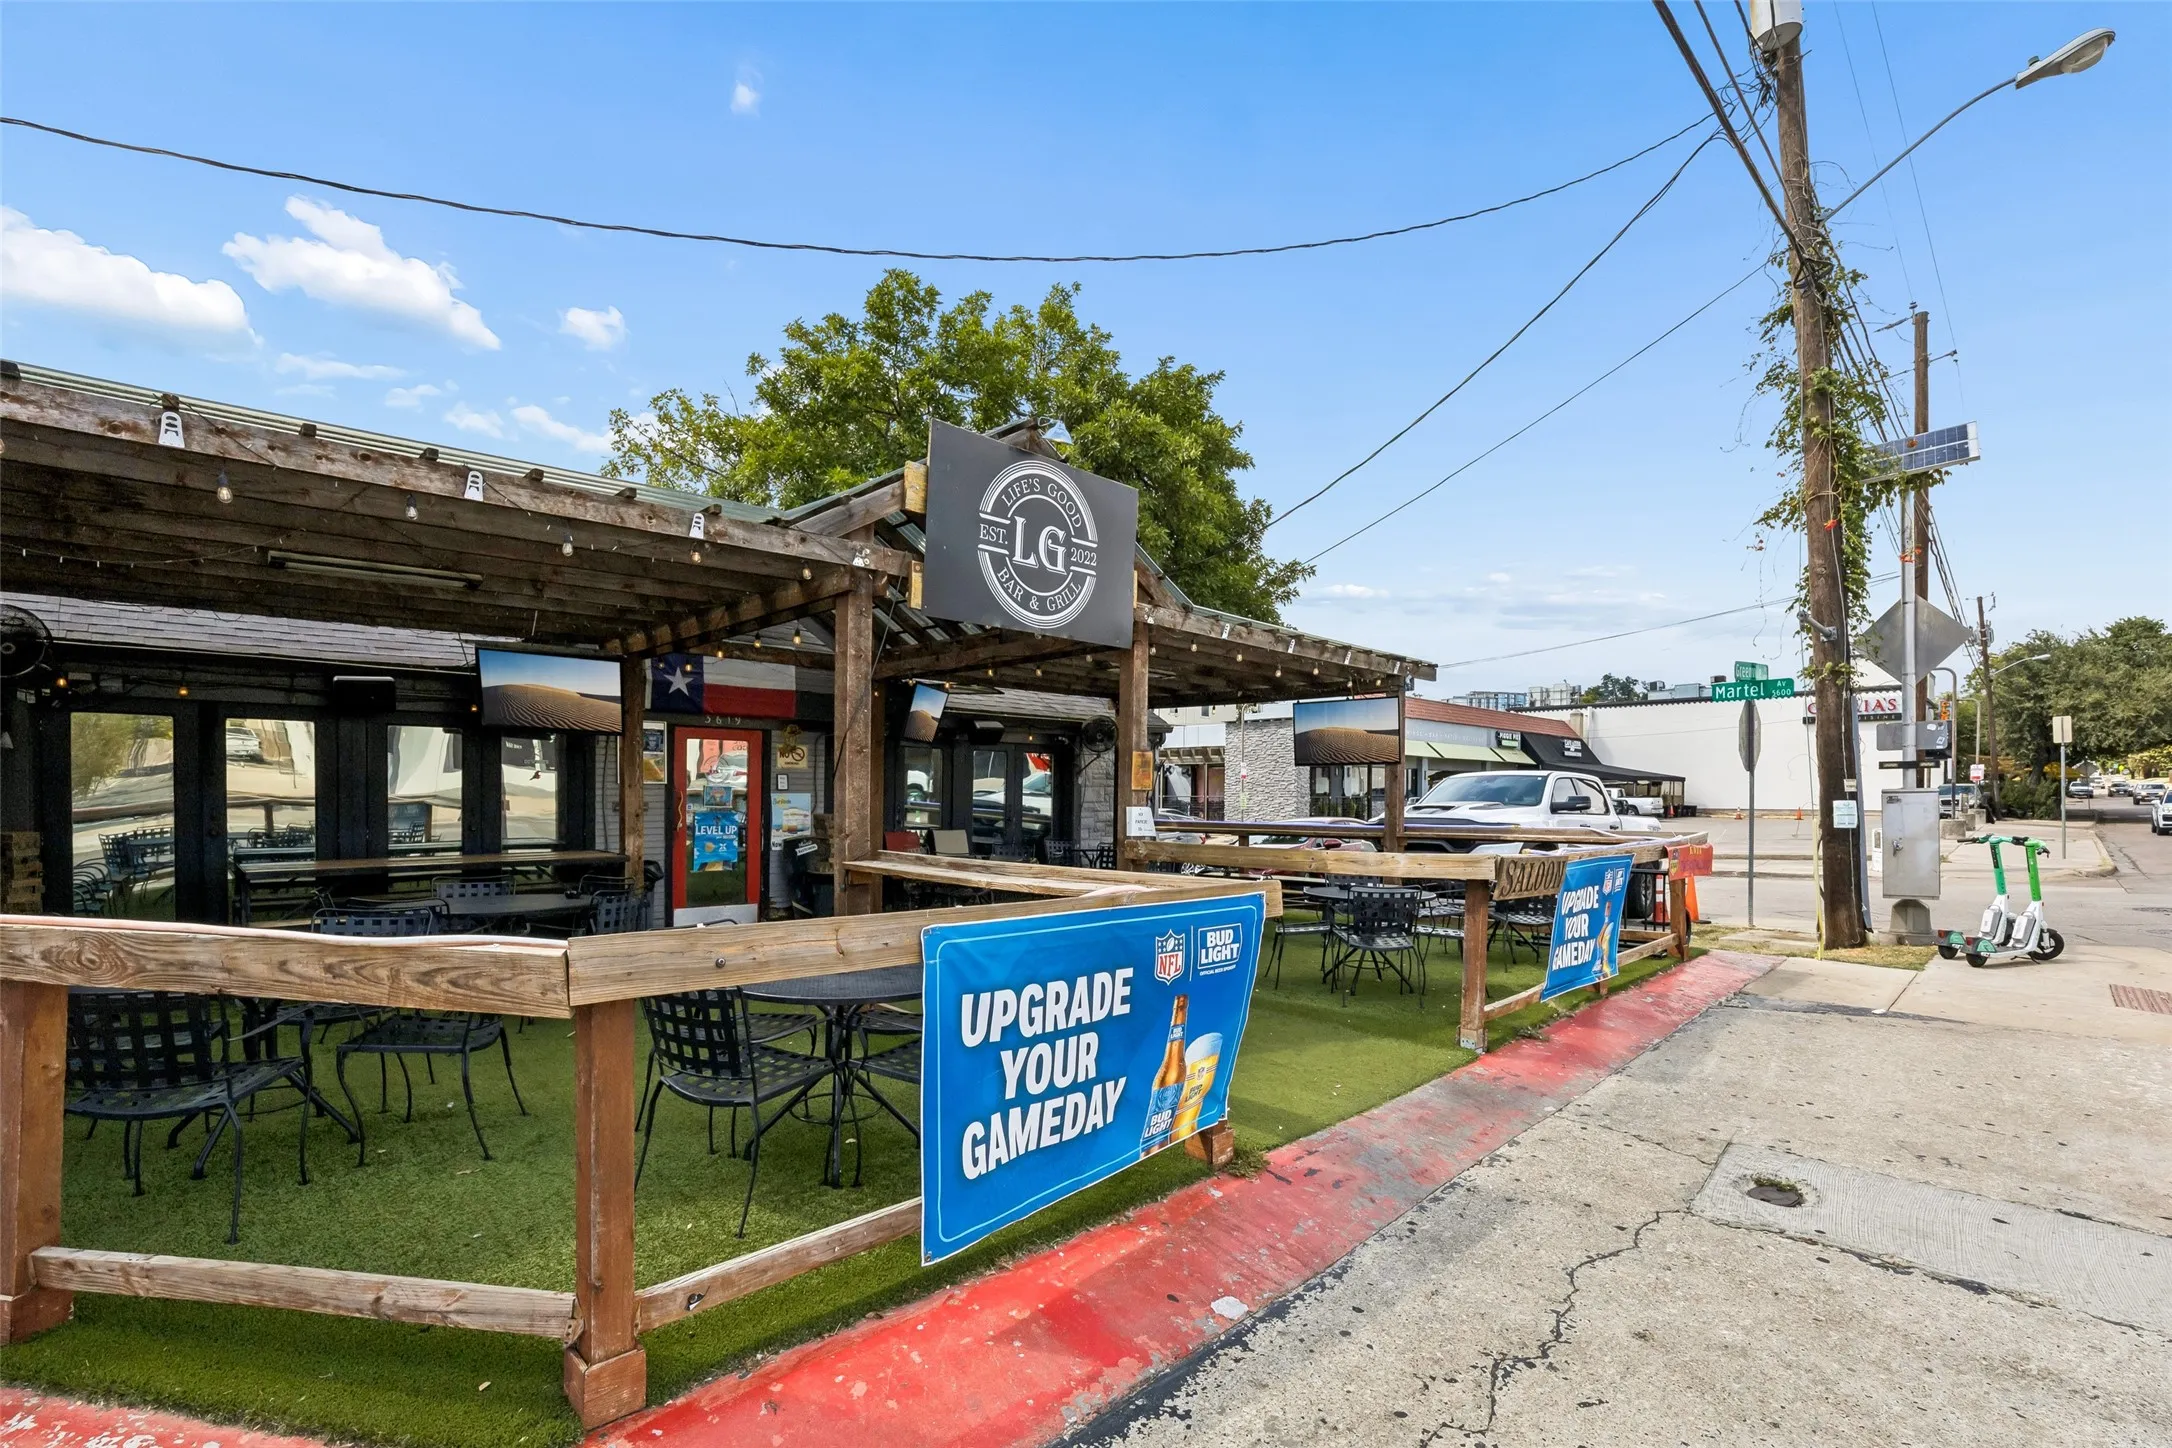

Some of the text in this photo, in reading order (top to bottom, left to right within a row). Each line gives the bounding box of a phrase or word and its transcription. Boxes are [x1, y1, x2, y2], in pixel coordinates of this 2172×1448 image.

[1001, 478, 1082, 528] LIFE'S GOOD
[980, 524, 1008, 544] EST.
[1012, 515, 1067, 575] LG
[1070, 547, 1097, 566] 2022
[996, 567, 1082, 611] BAR & GRILL
[1715, 682, 1764, 699] Martel
[1772, 689, 1791, 698] 5600
[695, 825, 737, 835] LEVEL UP
[1500, 860, 1567, 897] SALOON
[1565, 913, 1589, 940] YOUR
[1207, 929, 1233, 947] BUD
[1159, 953, 1182, 976] NFL
[1201, 943, 1239, 964] LIGHT
[960, 967, 1134, 1048] UPGRADE
[999, 1032, 1099, 1100] YOUR
[961, 1076, 1127, 1180] GAMEDAY
[1144, 1119, 1172, 1138] LIGHT
[1150, 1109, 1172, 1126] BUD
